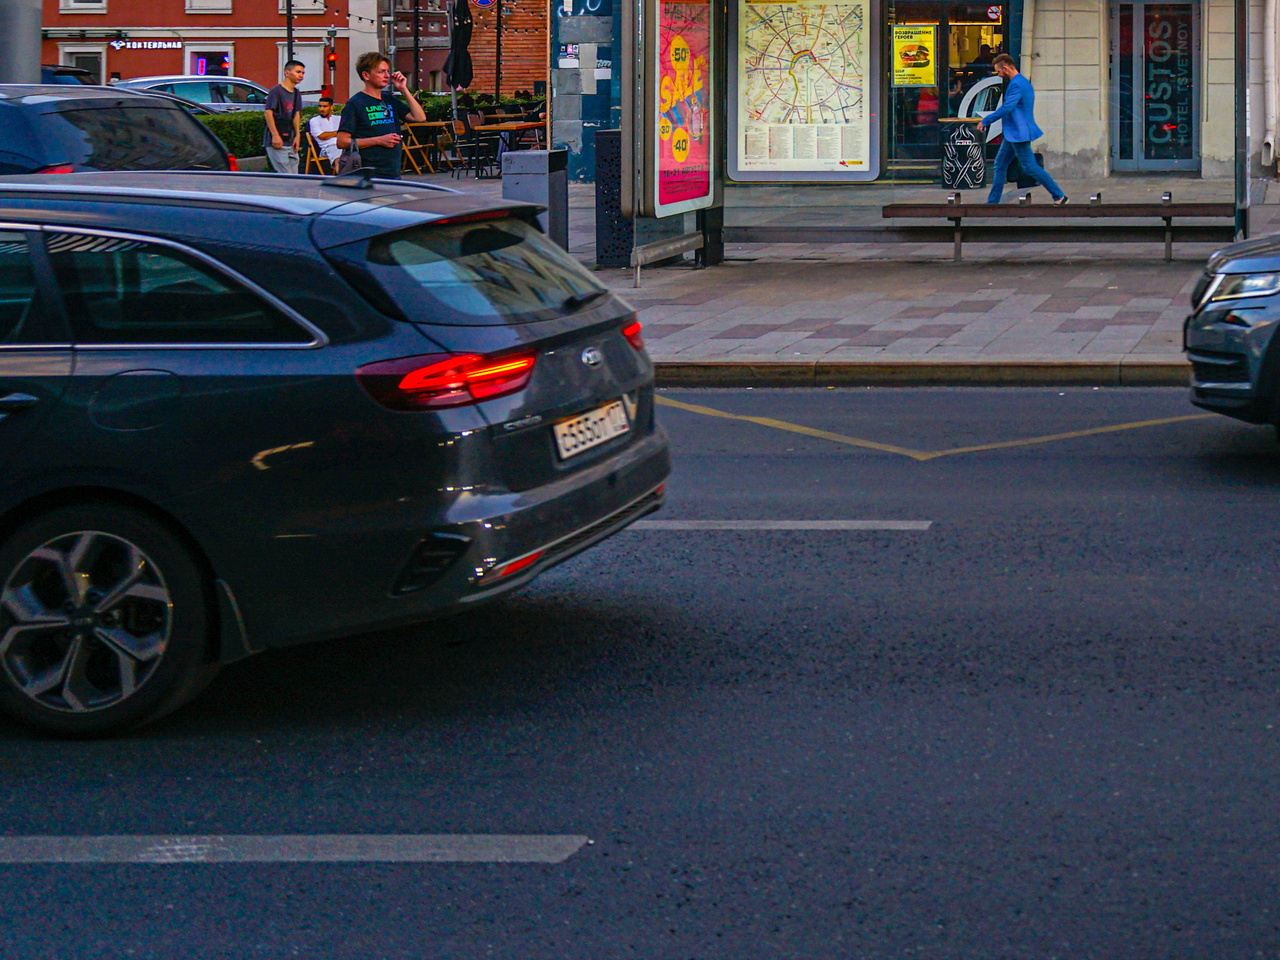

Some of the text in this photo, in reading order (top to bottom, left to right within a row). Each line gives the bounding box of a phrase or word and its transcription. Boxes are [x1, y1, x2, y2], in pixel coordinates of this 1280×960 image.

[365, 104, 393, 113] UNDR
[1148, 20, 1173, 144] CUSTOS
[1177, 21, 1189, 144] HOTEL TSVETNOY
[370, 117, 395, 126] ARMOU
